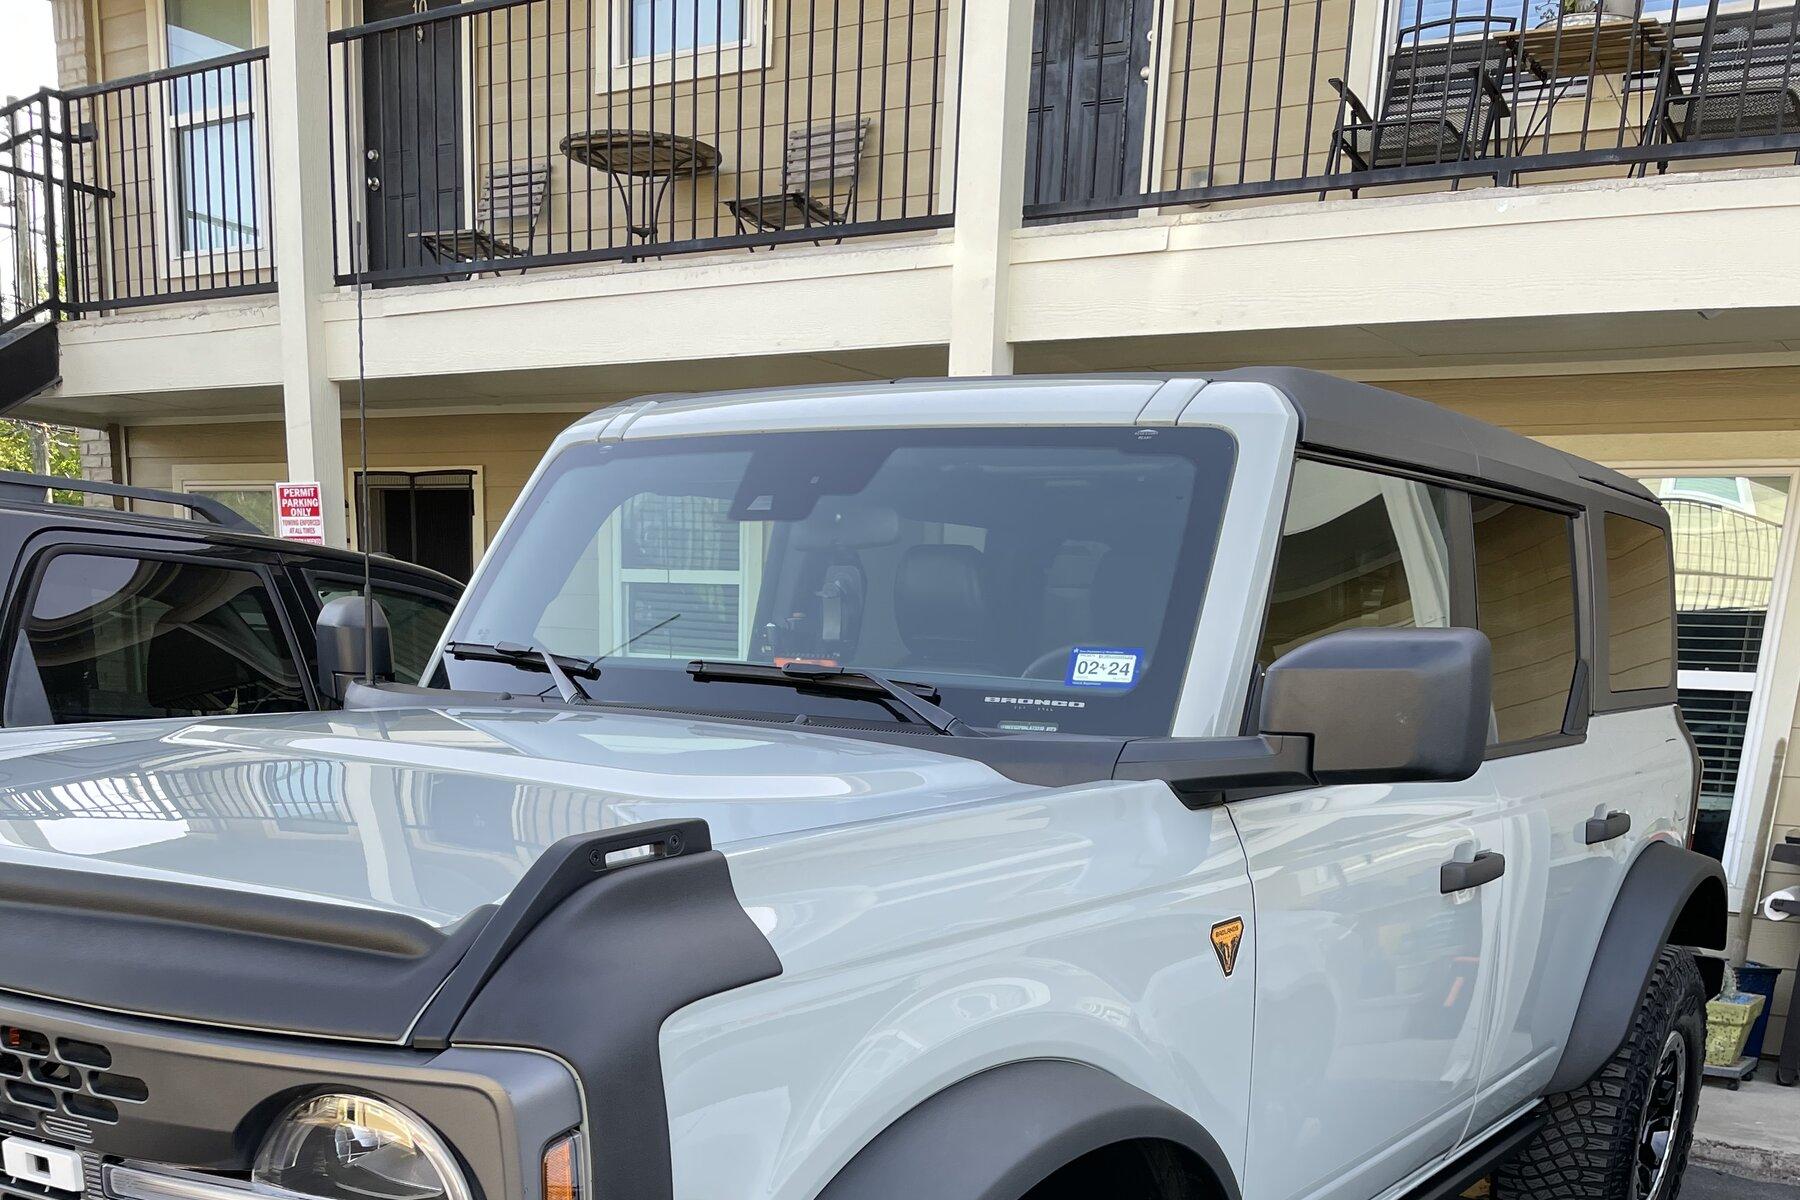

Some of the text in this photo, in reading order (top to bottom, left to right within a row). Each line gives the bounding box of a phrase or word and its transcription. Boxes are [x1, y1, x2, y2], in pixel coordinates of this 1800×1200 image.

[283, 488, 315, 497] PERMIT
[281, 498, 319, 508] PARKING
[290, 508, 312, 517] ONLY
[1077, 660, 1131, 676] 02 24
[984, 696, 1085, 708] BRONCO
